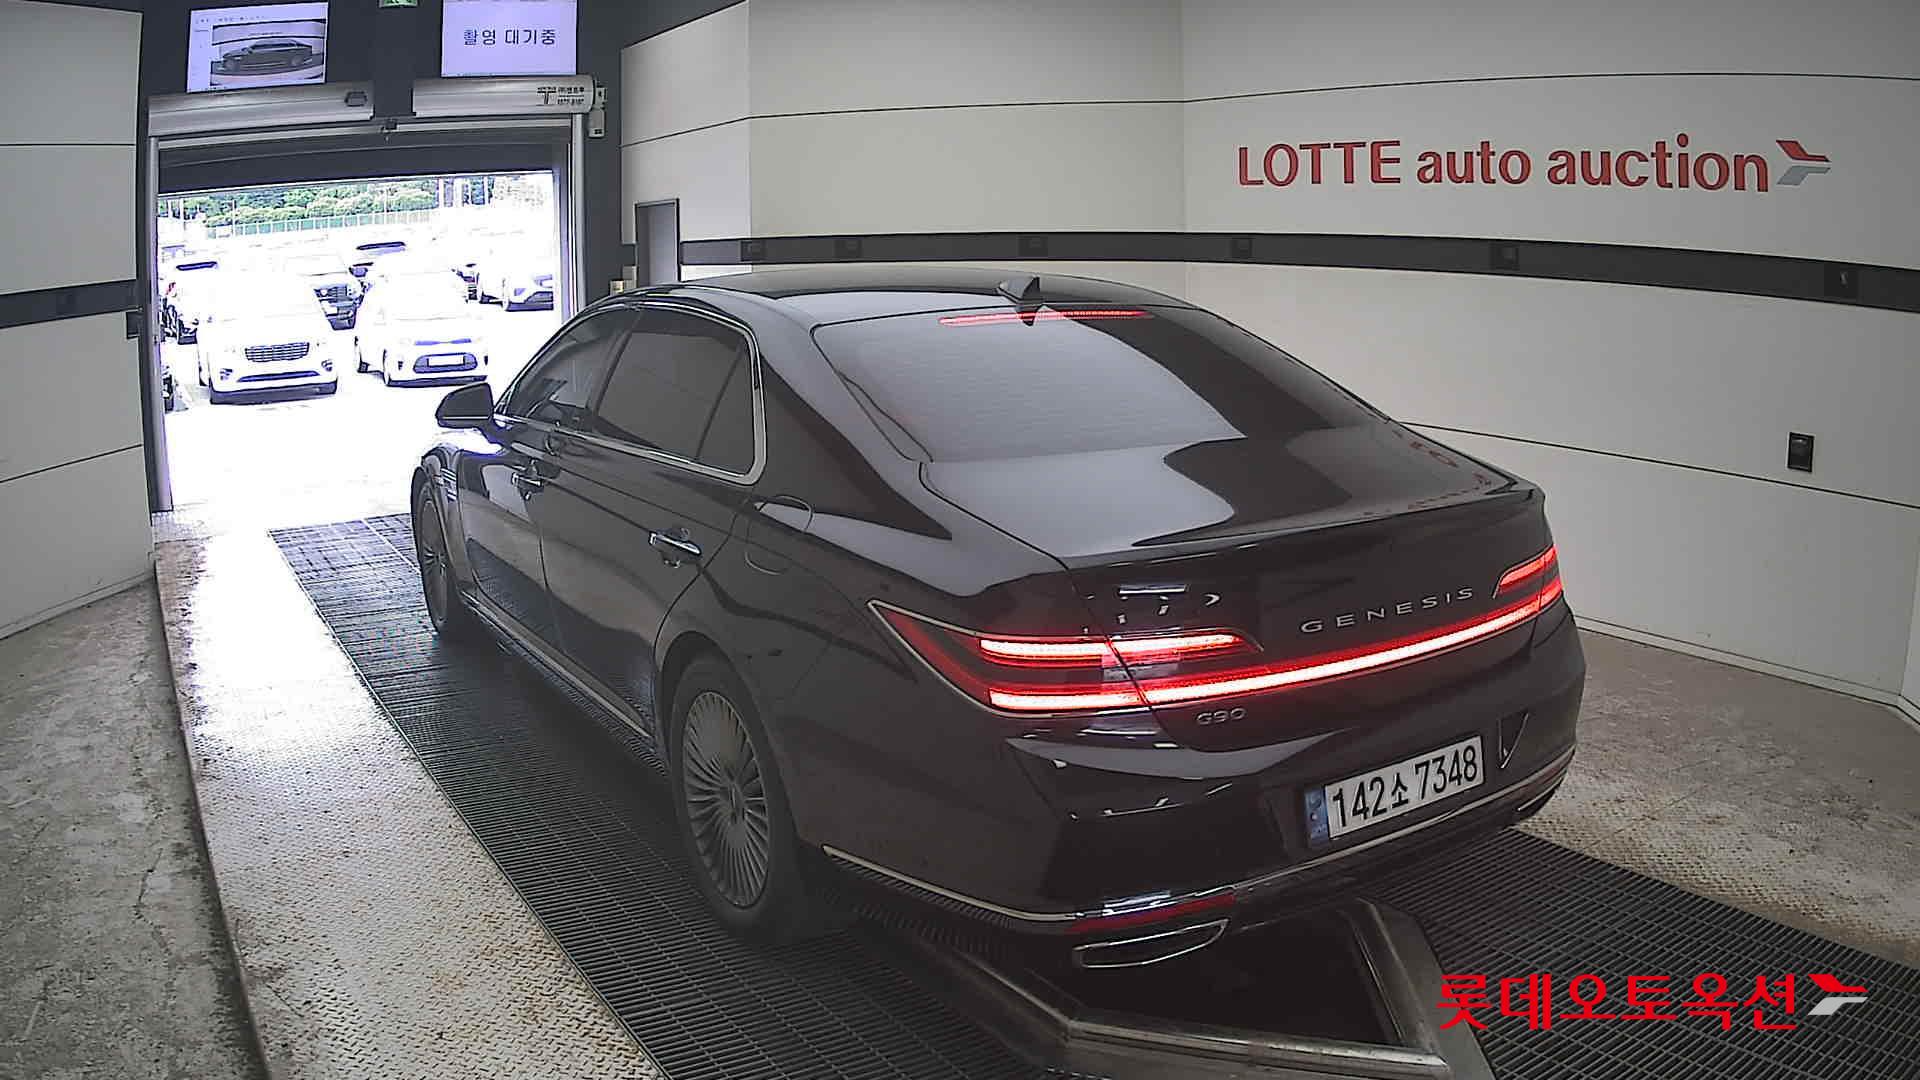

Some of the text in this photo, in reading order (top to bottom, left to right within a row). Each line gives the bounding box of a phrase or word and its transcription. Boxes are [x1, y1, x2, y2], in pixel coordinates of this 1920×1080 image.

[463, 29, 556, 46] 촬영 대기중
[1239, 133, 1770, 193] LOTTE auto auction
[1300, 586, 1474, 633] GENESIS
[1196, 707, 1247, 725] G90
